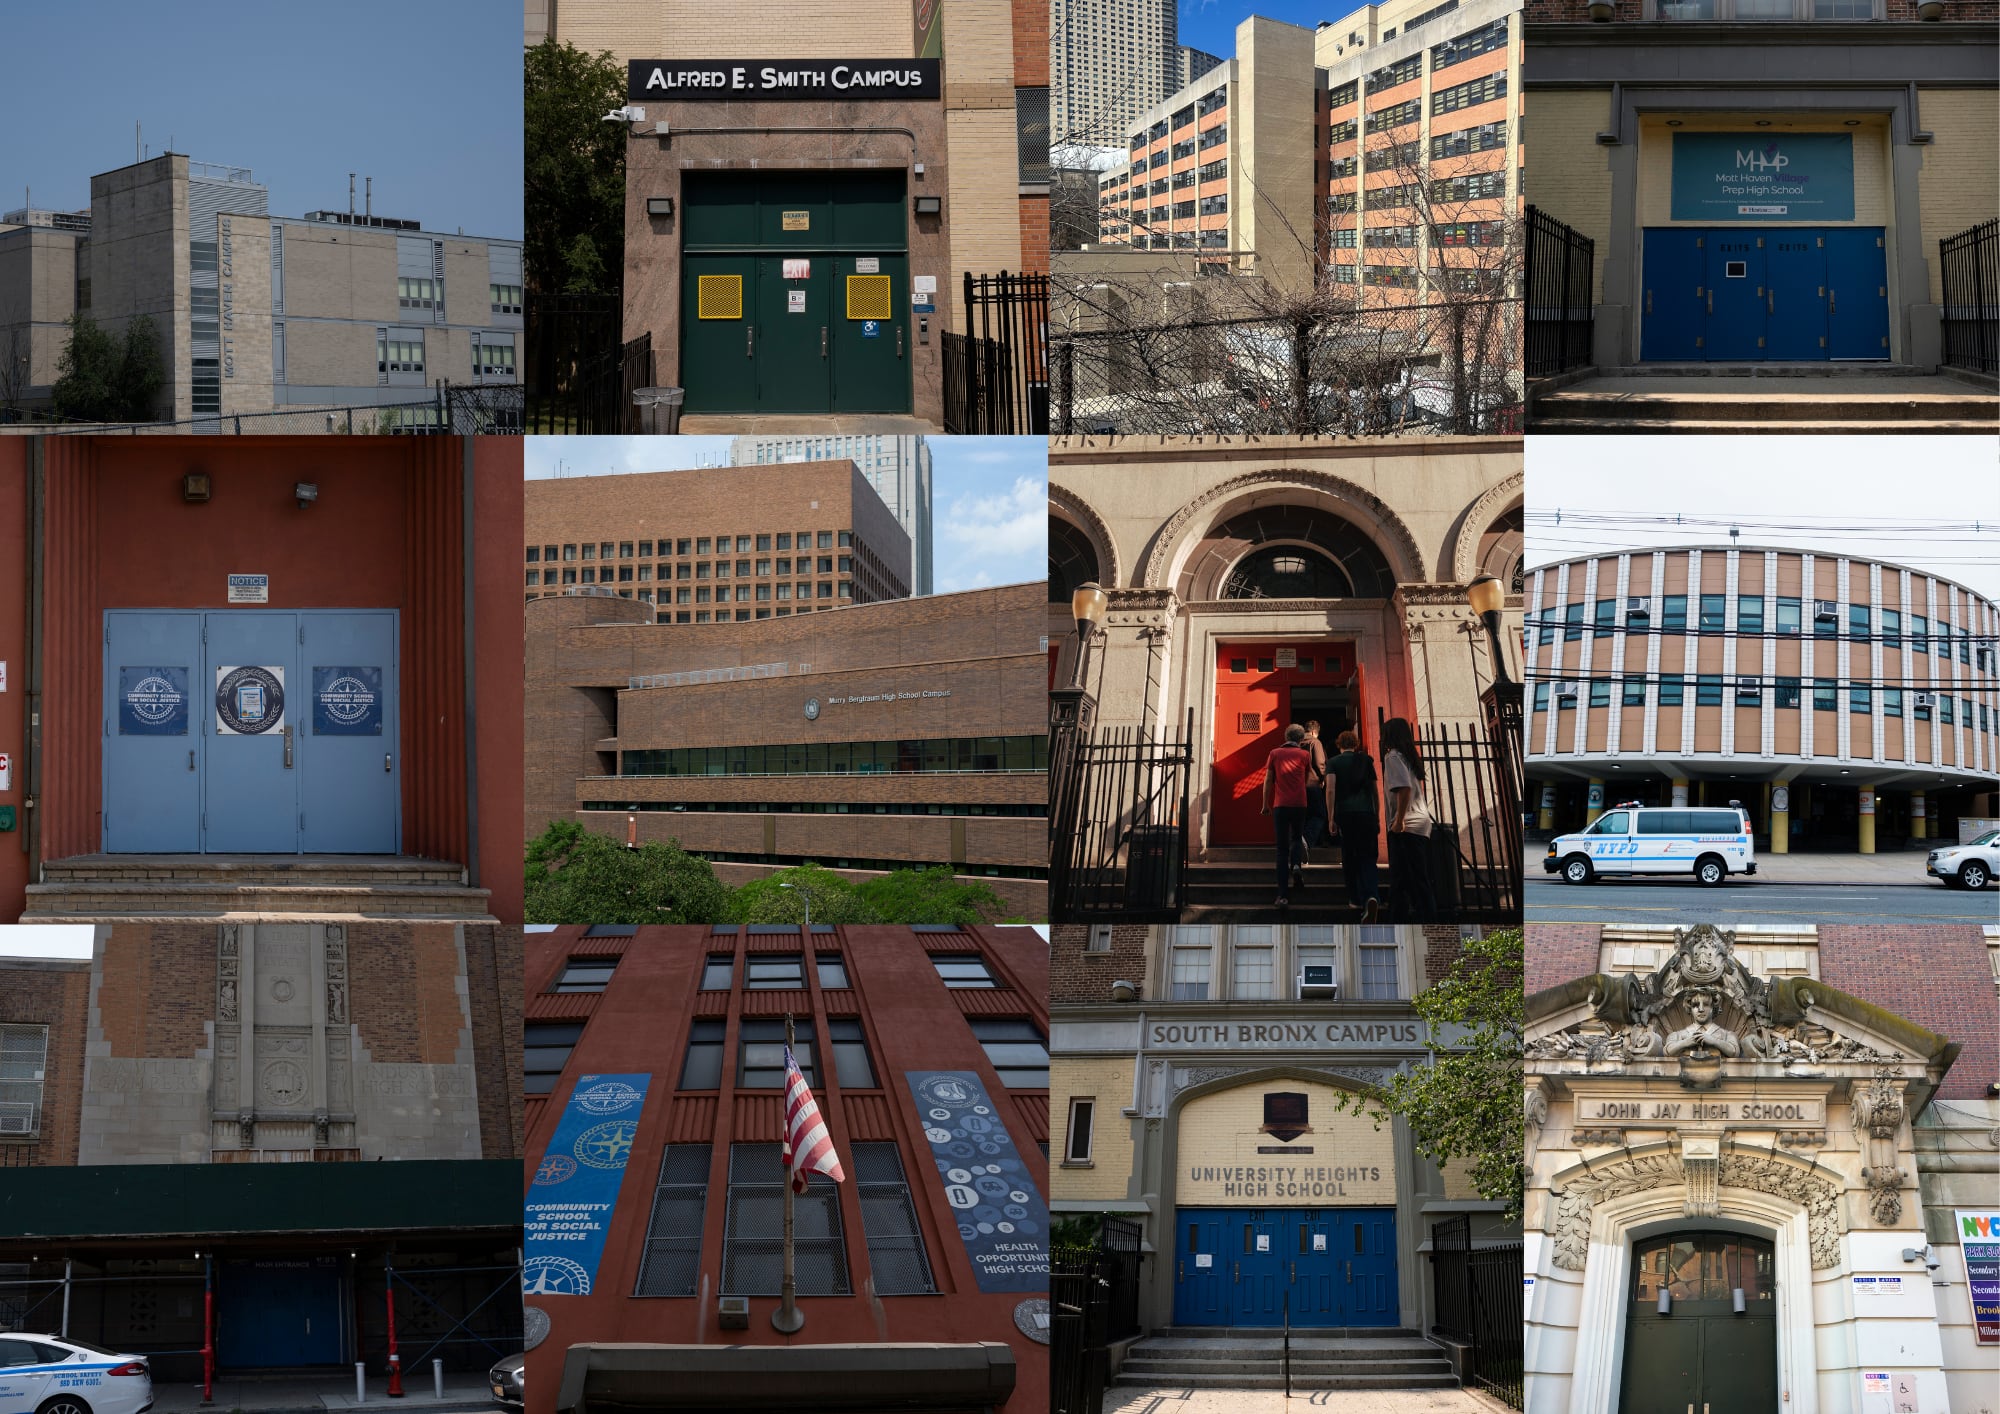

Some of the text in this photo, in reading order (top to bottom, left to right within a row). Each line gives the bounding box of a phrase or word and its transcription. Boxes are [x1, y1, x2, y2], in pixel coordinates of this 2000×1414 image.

[731, 67, 753, 89] E.
[1716, 174, 1809, 184] Mott Haven Village
[1722, 185, 1804, 196] Prep High School
[222, 219, 233, 379] MOTT HAVEN CAMPUS
[231, 577, 265, 585] NOTICE
[828, 690, 951, 705] Murry Bergtraum High School Campus
[1595, 842, 1640, 855] NYPD
[1152, 1024, 1418, 1043] SOUTH BRONX CAMPUS
[1596, 1103, 1805, 1120] JOHN JAY HIGH SCHOOL
[1191, 1167, 1380, 1181] UNIVERSITY HEIGHTS
[1224, 1182, 1348, 1197] HIGH SCHOOL
[525, 1203, 611, 1212] COMMUNITY
[536, 1212, 591, 1221] SCHOOL
[524, 1222, 601, 1231] FOR SOCIAL
[527, 1232, 587, 1241] JUSTICE
[994, 1243, 1039, 1252] HEALTH
[1965, 1245, 1986, 1258] PARK
[975, 1253, 1050, 1263] OPPORTUNIT
[983, 1265, 1016, 1274] HIGH
[1968, 1265, 1998, 1277] Secondary
